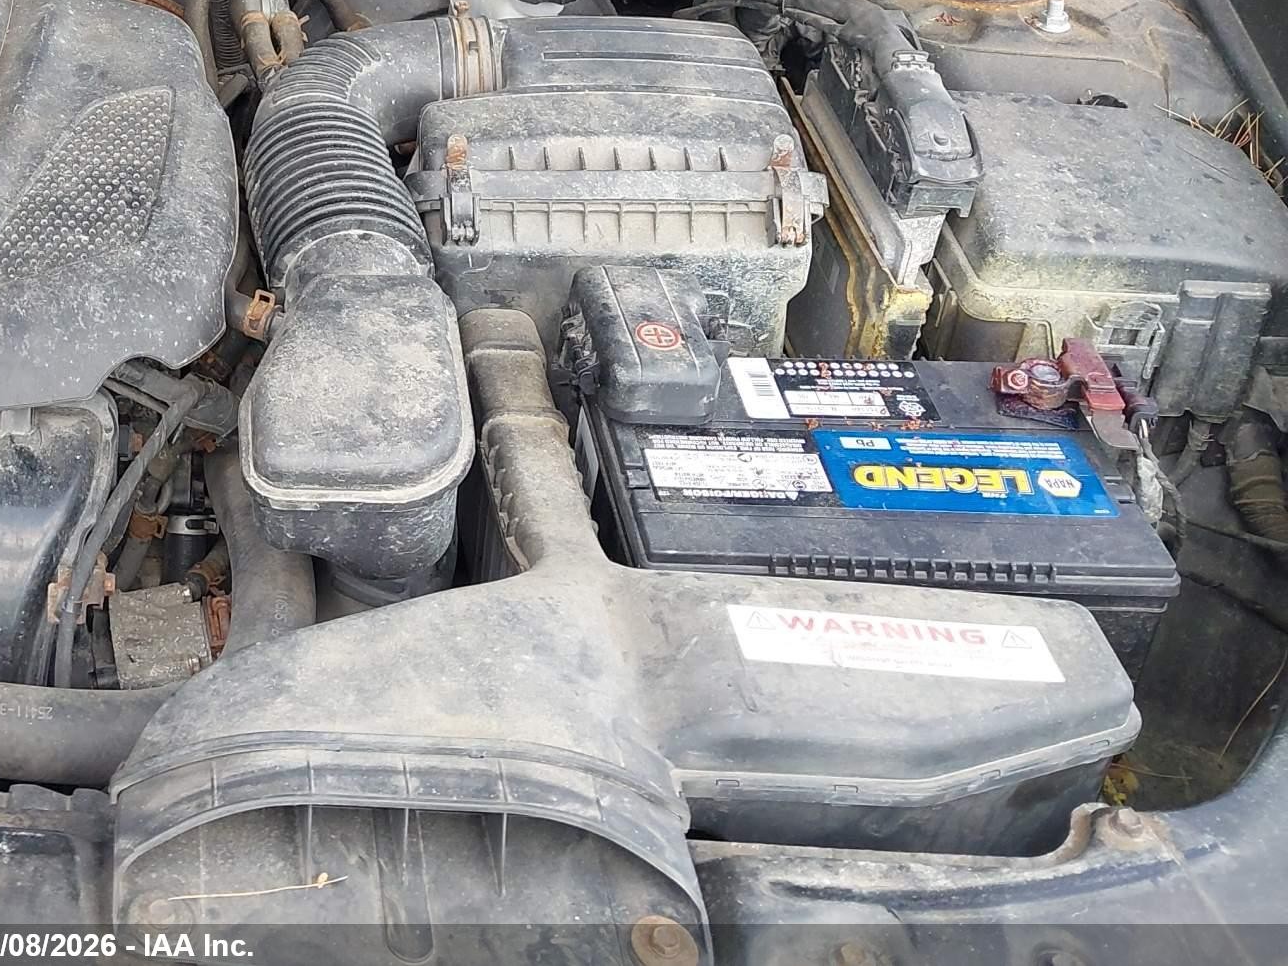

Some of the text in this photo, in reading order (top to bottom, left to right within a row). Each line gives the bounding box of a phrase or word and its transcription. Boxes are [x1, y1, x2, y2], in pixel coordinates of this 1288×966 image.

[855, 438, 876, 448] Pb
[853, 465, 1034, 495] LEGEND
[1045, 477, 1074, 489] NAPA
[777, 613, 987, 646] WARNING
